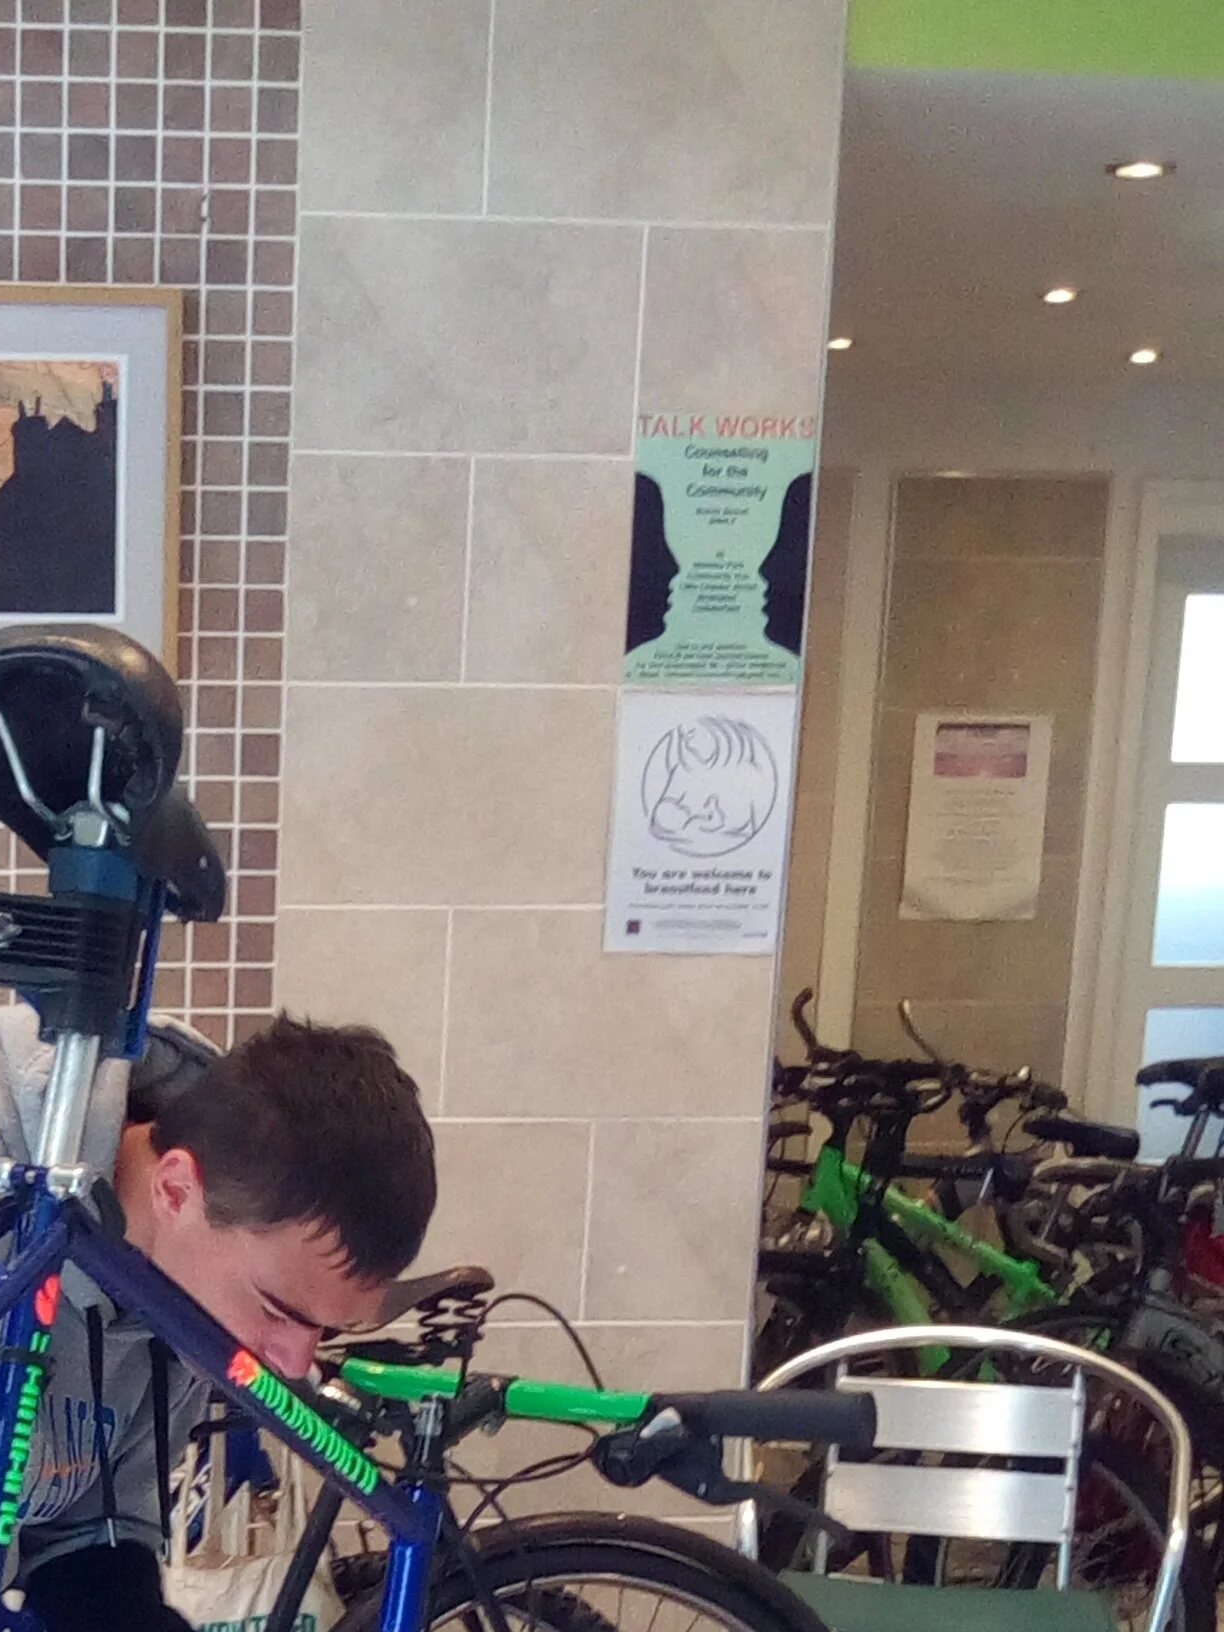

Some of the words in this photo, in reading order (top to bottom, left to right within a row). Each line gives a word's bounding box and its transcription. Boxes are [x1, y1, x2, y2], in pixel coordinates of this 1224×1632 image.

[639, 415, 706, 438] TALK
[716, 415, 816, 438] WORKS
[702, 463, 723, 478] for
[726, 465, 748, 478] the
[632, 868, 657, 880] You
[662, 870, 687, 880] are
[692, 868, 753, 880] welcome
[758, 869, 772, 880] to
